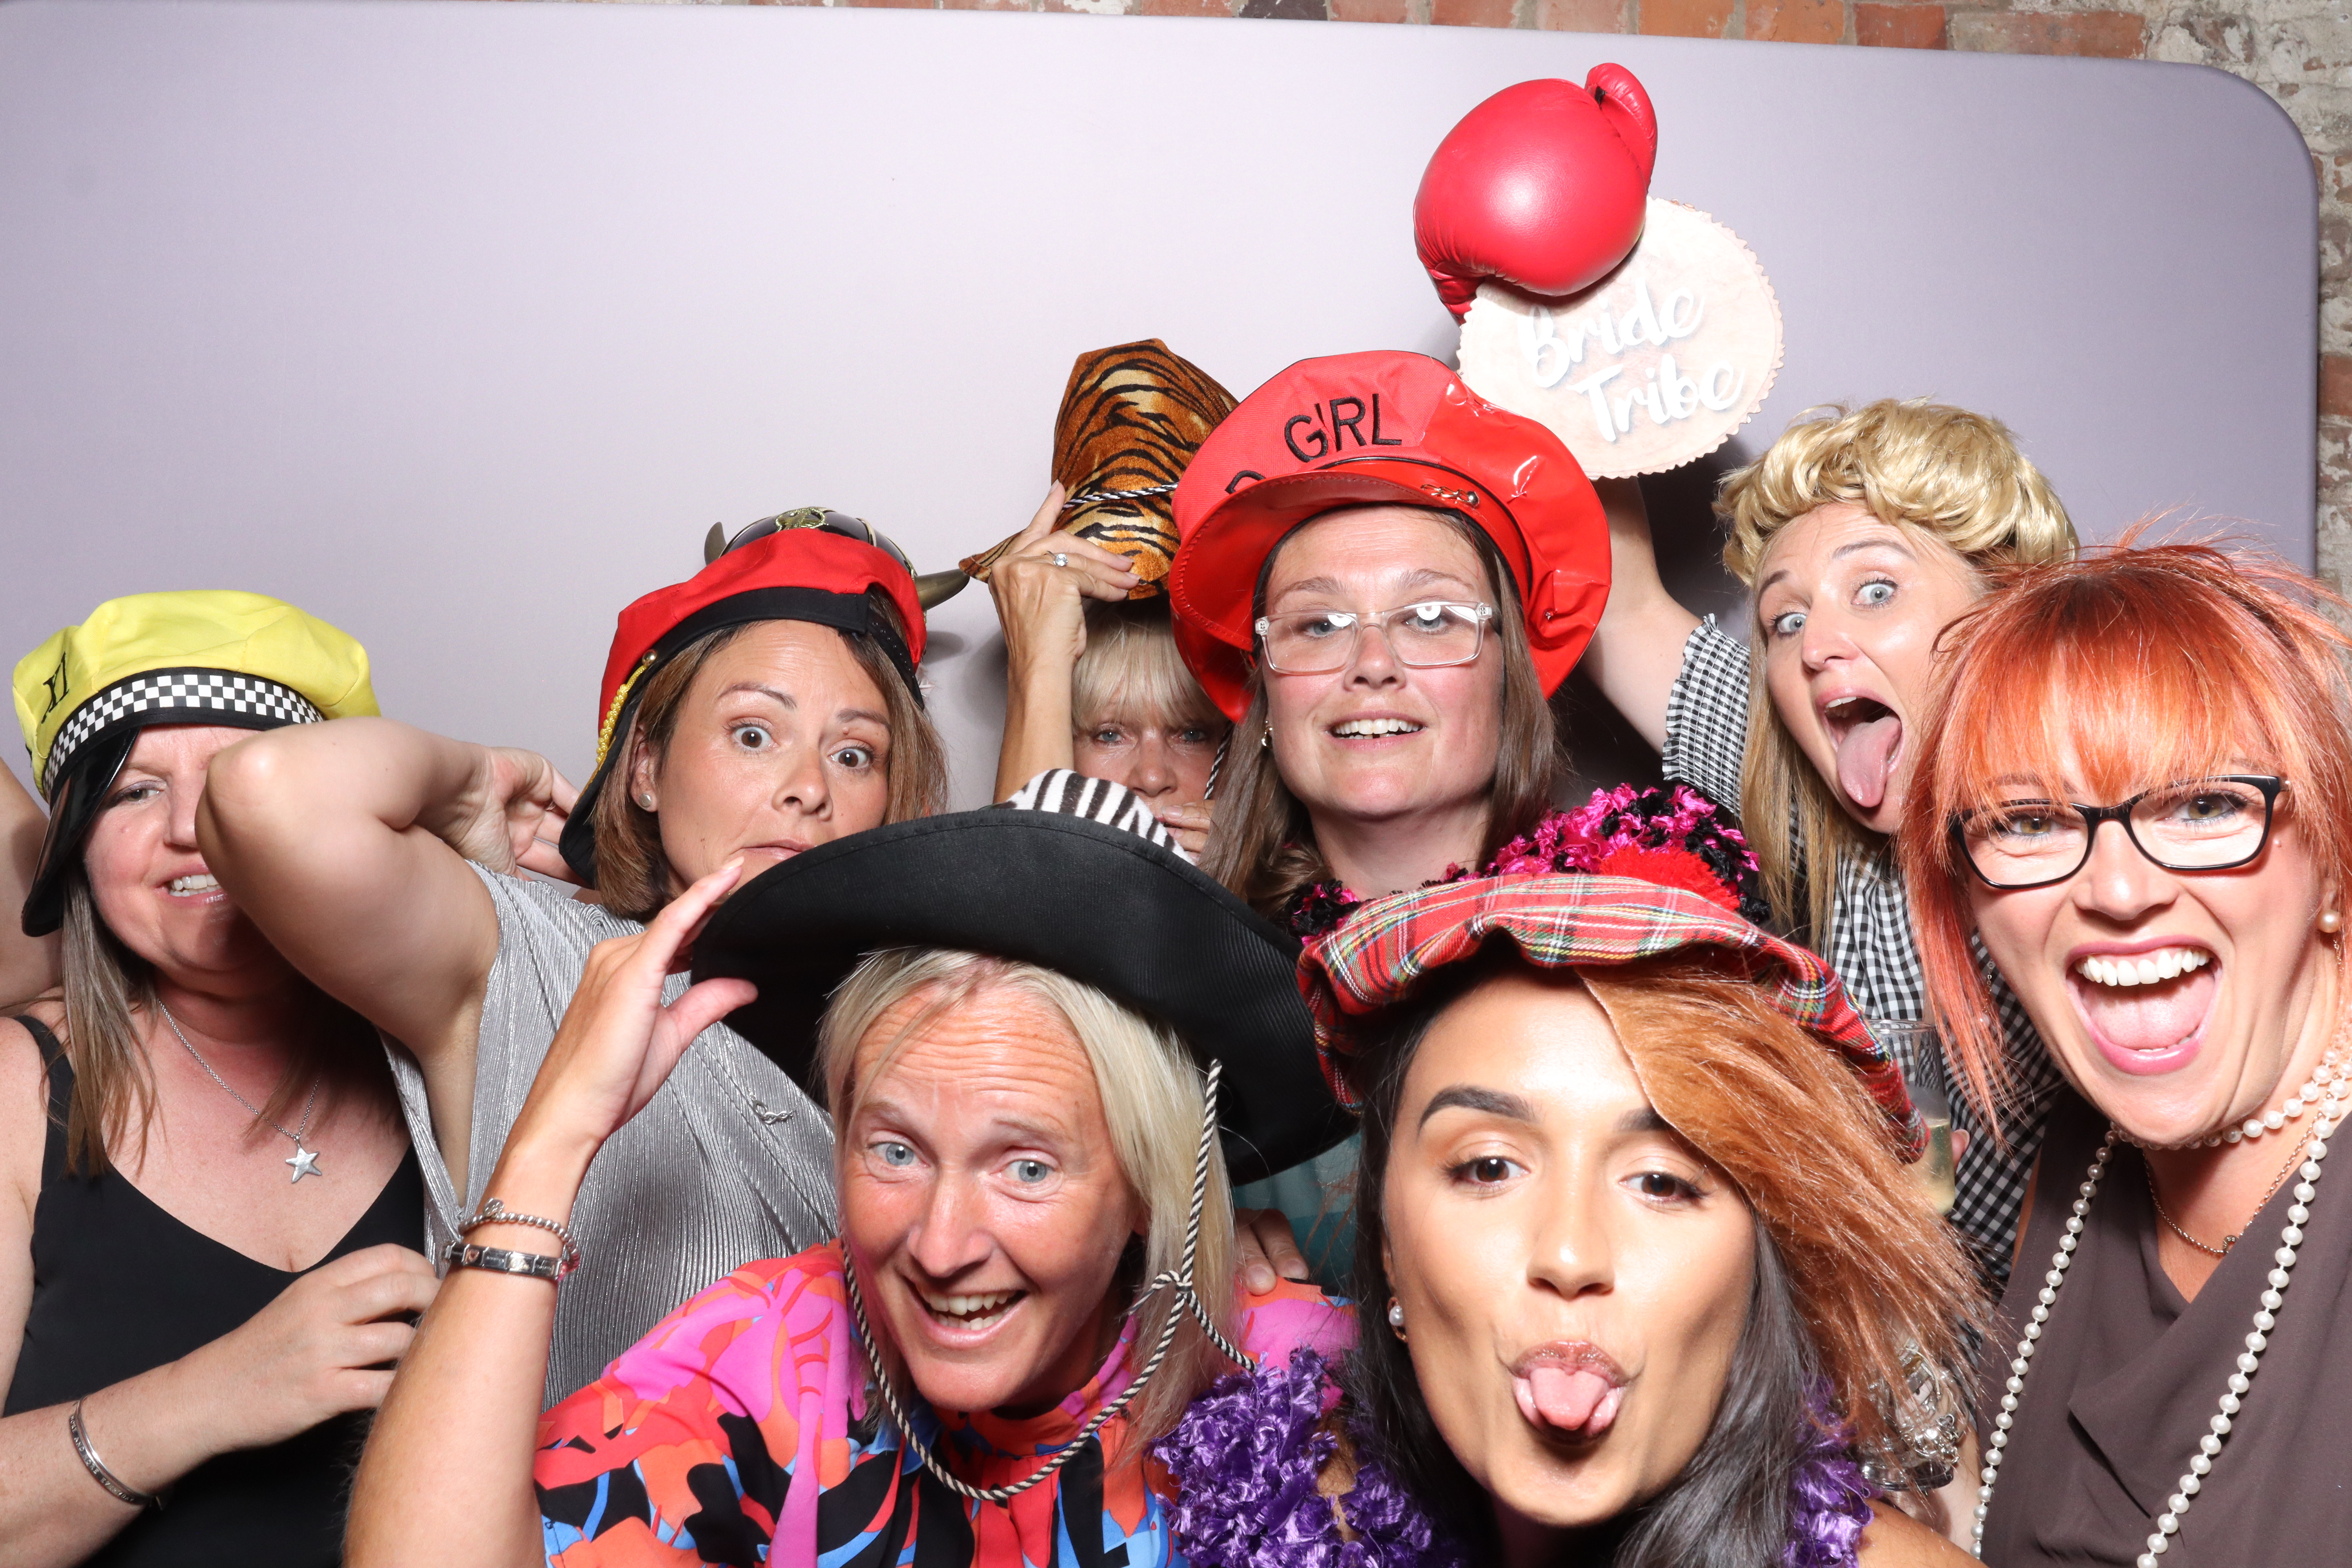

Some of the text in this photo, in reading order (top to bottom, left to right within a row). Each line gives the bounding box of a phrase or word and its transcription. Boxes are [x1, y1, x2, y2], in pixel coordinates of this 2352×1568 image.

[1516, 277, 1705, 388] Bride
[1567, 354, 1745, 442] Tribe
[41, 651, 69, 724] XI
[74, 1436, 85, 1452] AND
[82, 1454, 100, 1474] MORE
